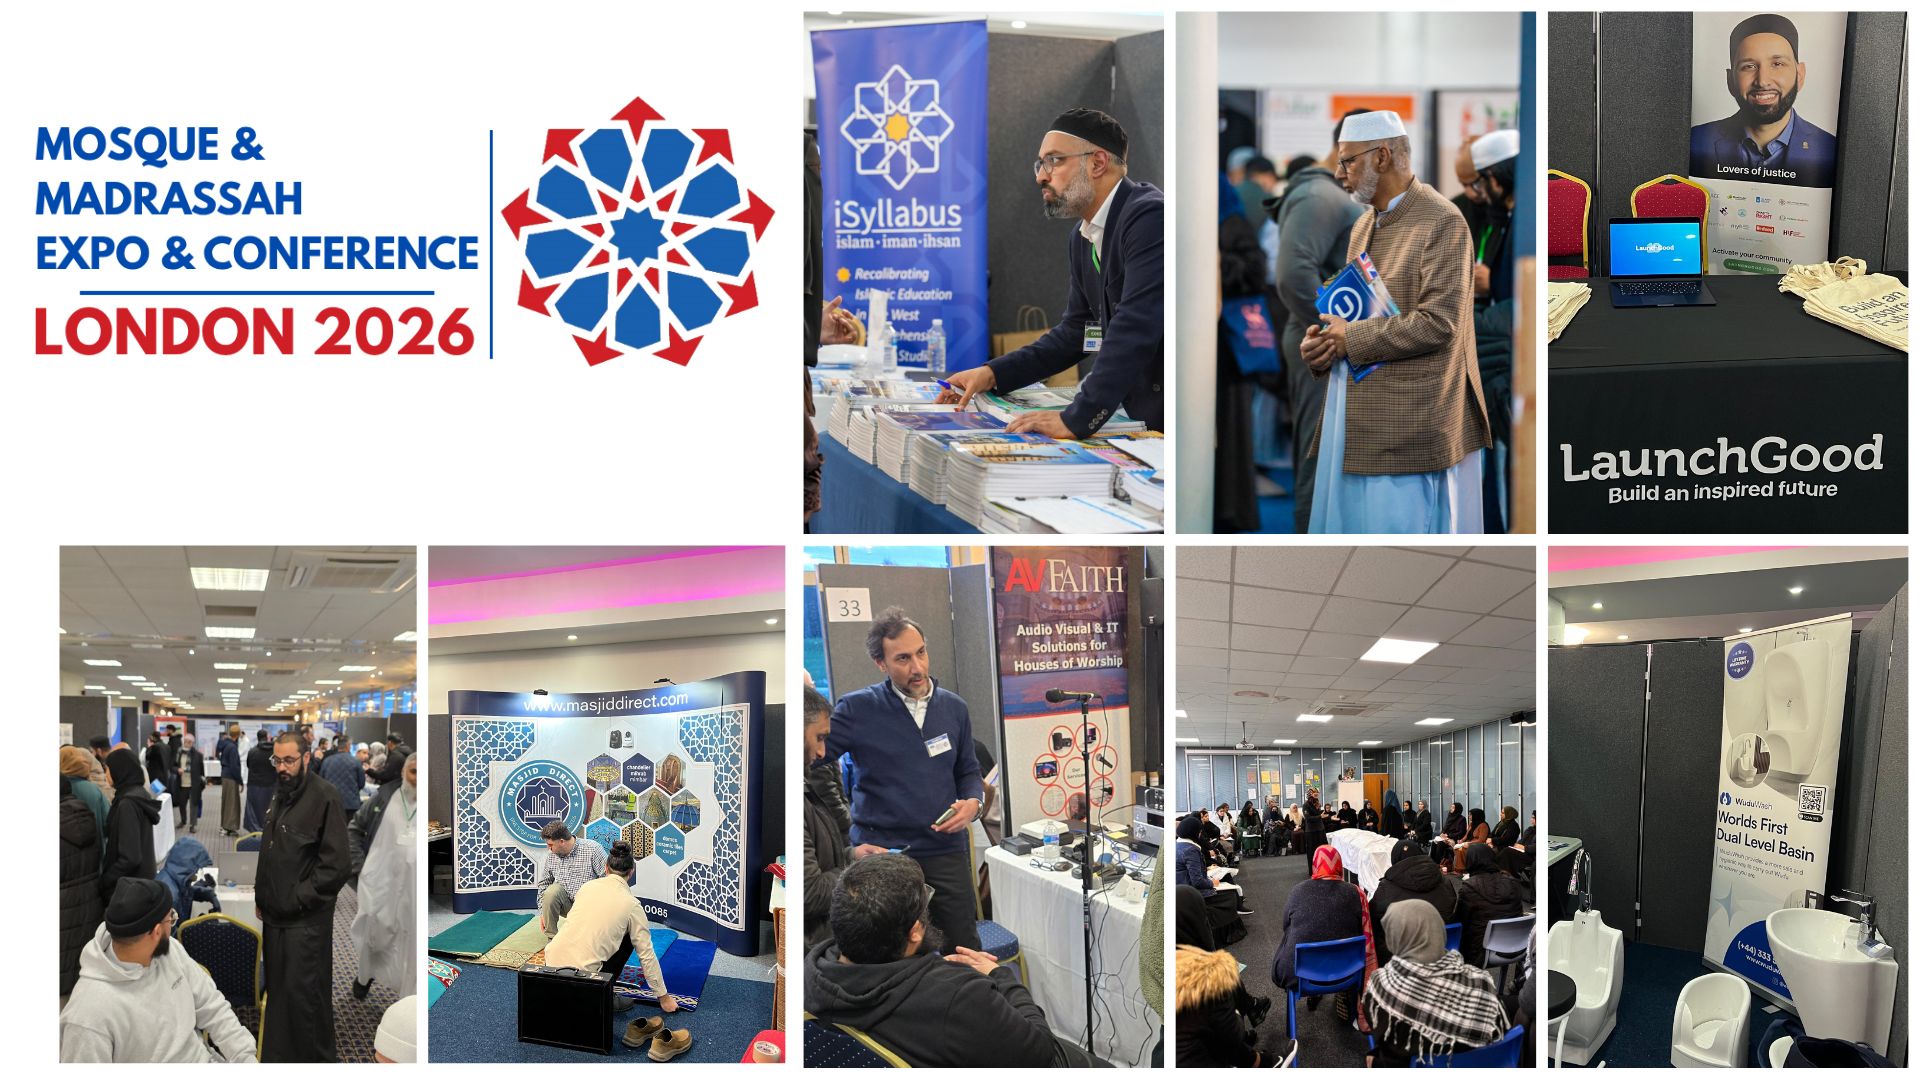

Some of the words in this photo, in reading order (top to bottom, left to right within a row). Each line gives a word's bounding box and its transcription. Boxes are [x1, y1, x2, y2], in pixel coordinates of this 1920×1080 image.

[1717, 164, 1749, 175] Lovers
[1751, 166, 1761, 176] of
[1763, 168, 1796, 179] justice
[835, 198, 962, 235] iSyllabus
[1712, 248, 1739, 256] Activate
[1755, 254, 1792, 265] community
[855, 267, 930, 282] Recalibrating
[898, 288, 952, 300] Education
[1839, 298, 1886, 313] Build
[1882, 292, 1906, 302] an
[856, 308, 866, 320] in
[891, 309, 920, 321] West
[1560, 434, 1884, 482] LaunchGood
[1608, 484, 1660, 504] Build
[1664, 486, 1689, 501] an
[1694, 480, 1774, 501] inspired
[1778, 480, 1838, 498] future
[839, 600, 861, 617] 33
[1016, 624, 1052, 636] Audio
[1055, 623, 1091, 634] Visual
[1094, 623, 1103, 633] &
[1106, 622, 1119, 633] IT
[1032, 640, 1087, 653] Solutions
[1090, 639, 1107, 650] for
[1014, 660, 1059, 672] Houses
[1062, 658, 1074, 669] of
[1077, 655, 1123, 668] Worship
[524, 693, 688, 714] www.masjiddirect.com
[507, 768, 538, 796] MASJID
[550, 768, 578, 797] DIRECT
[1735, 798, 1773, 810] WuduWash
[1718, 810, 1757, 829] Worlds
[1761, 818, 1788, 835] First
[1717, 828, 1741, 844] Dual
[1745, 833, 1775, 852] Level
[1779, 841, 1814, 862] Basin
[1738, 940, 1756, 956] (+44)
[1758, 950, 1771, 961] 333
